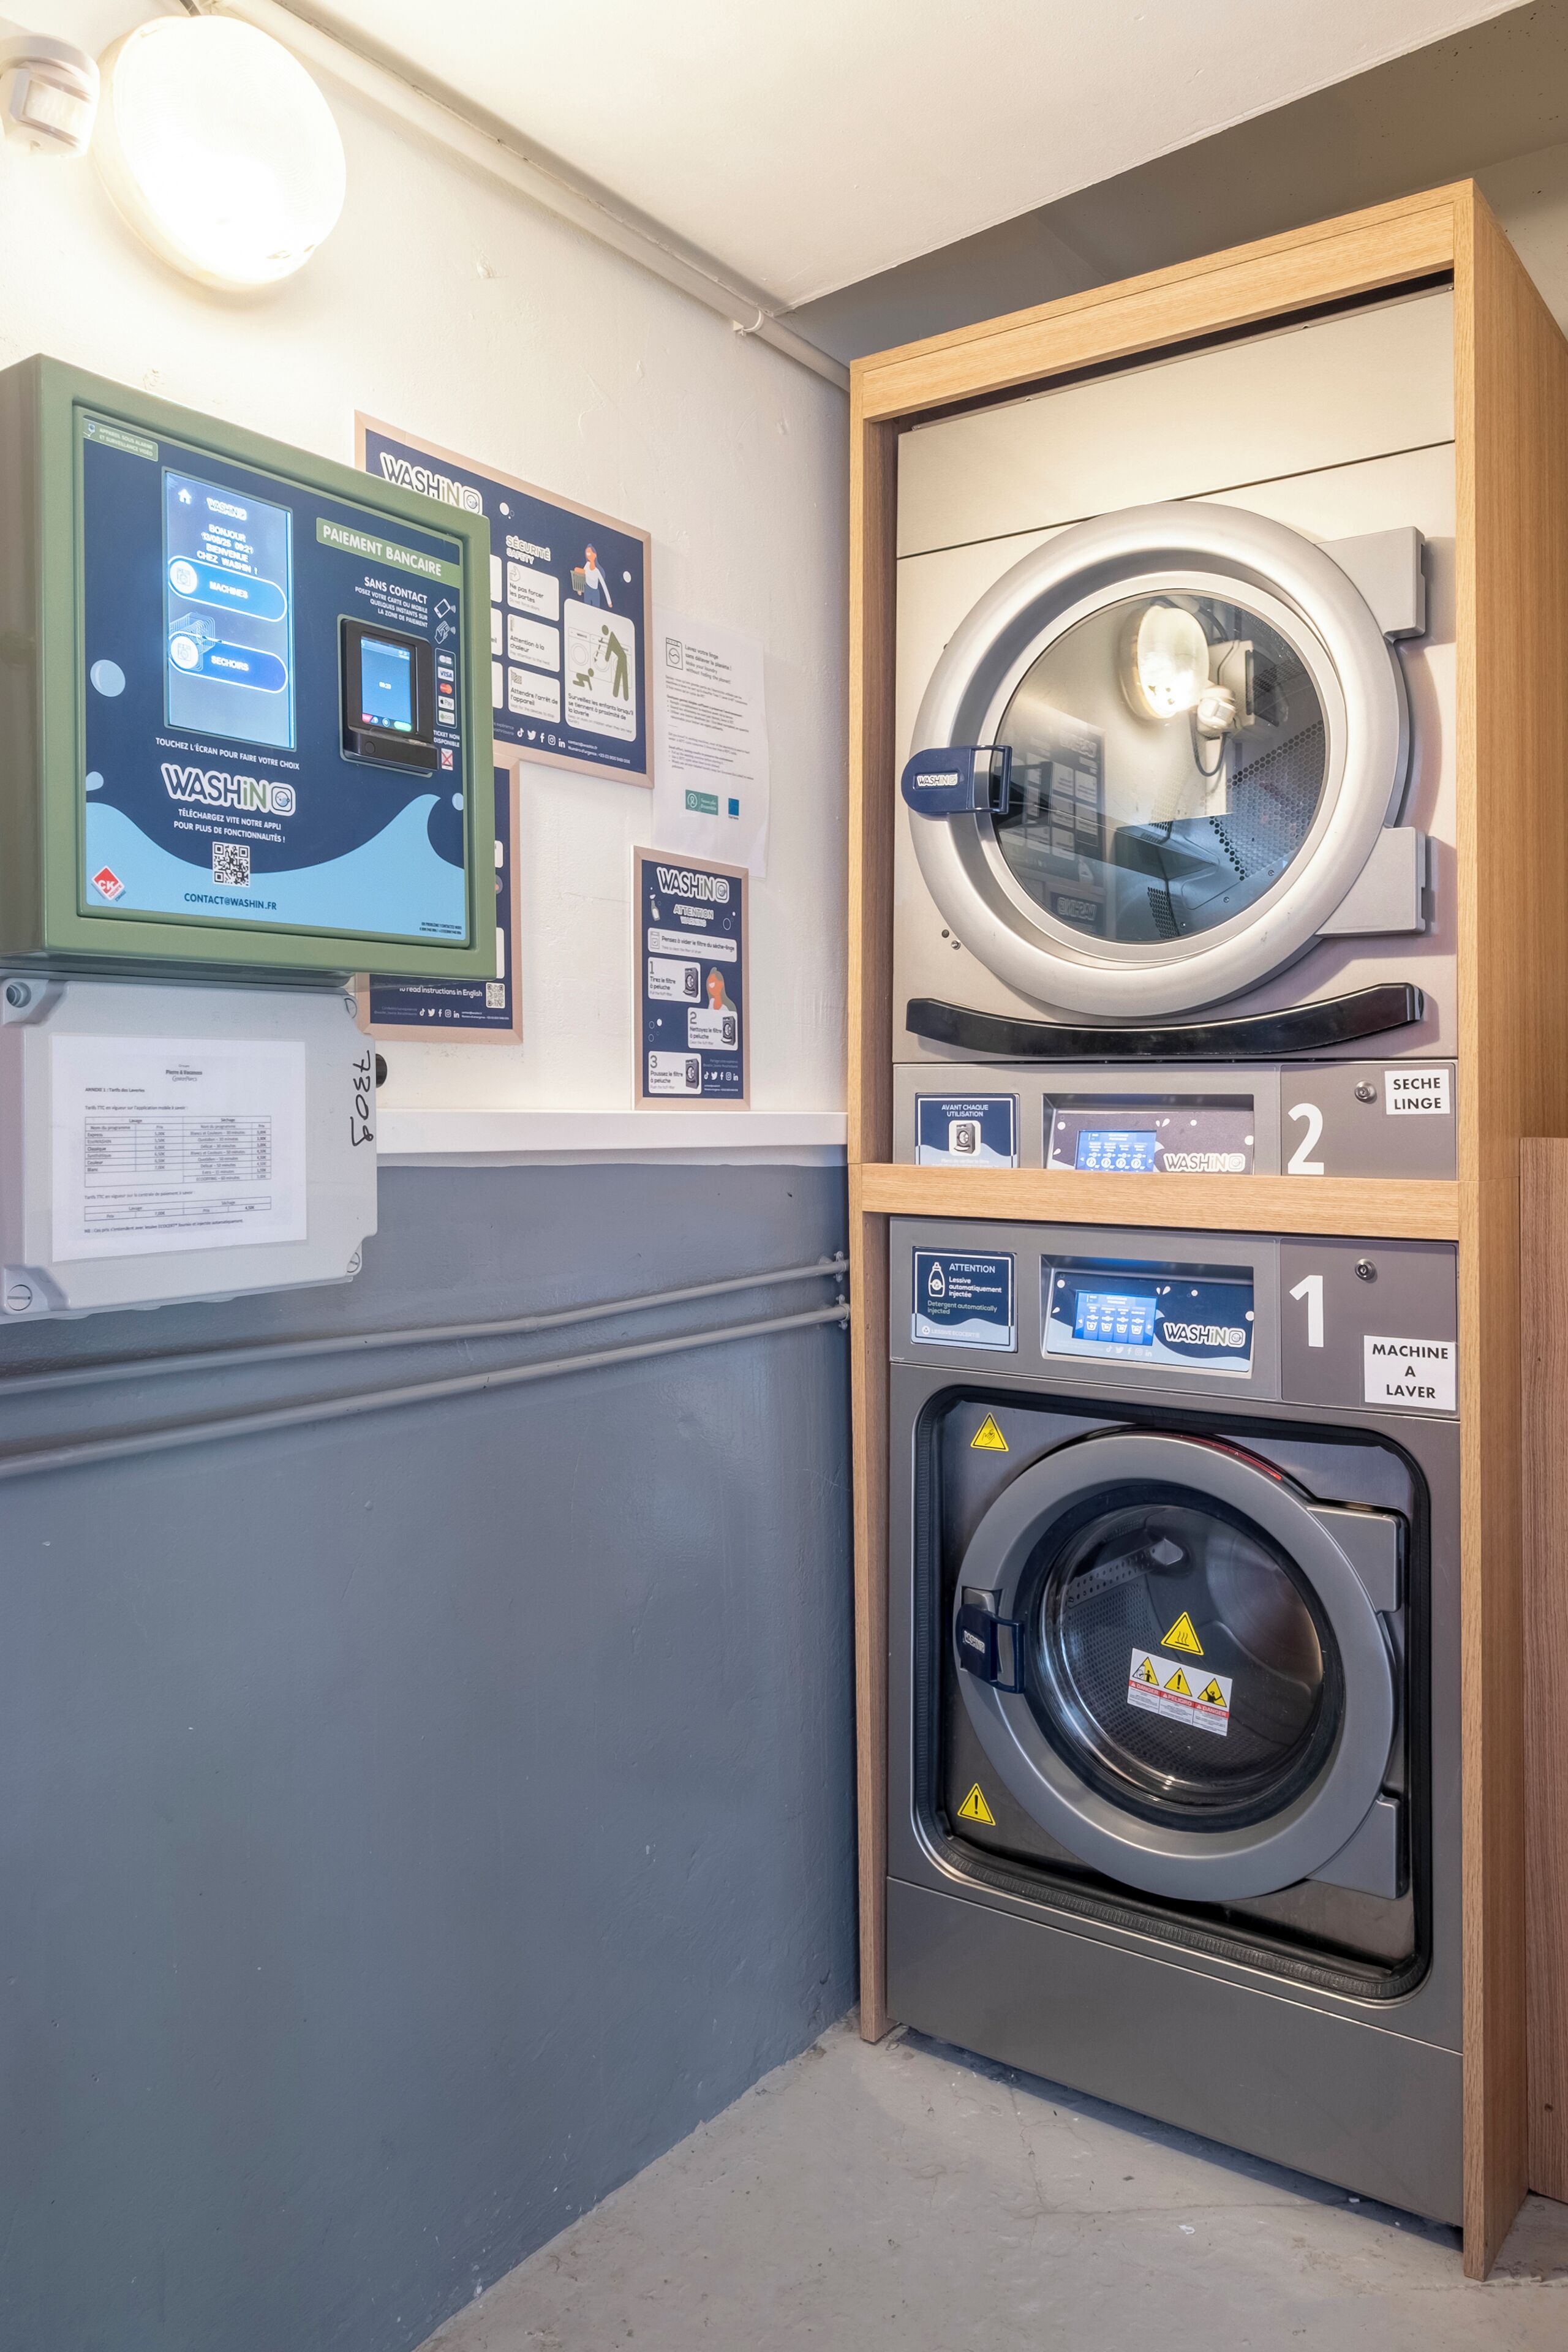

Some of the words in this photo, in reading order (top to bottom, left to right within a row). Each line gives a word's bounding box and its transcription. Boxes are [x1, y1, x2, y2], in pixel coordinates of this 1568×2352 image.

[121, 435, 134, 443] SOUS
[208, 524, 246, 543] BONJOUR
[206, 543, 249, 563] BIENVENUE
[323, 525, 382, 556] PAIEMENT
[386, 546, 442, 576] BANCAIRE
[506, 535, 551, 562] SÉCURITÉ
[197, 550, 219, 564] CHEZ
[221, 557, 252, 573] WASHIN
[506, 547, 535, 565] SAFETY
[209, 581, 248, 599] MACHINES
[364, 576, 387, 592] SANS
[389, 584, 428, 604] CONTACT
[528, 589, 544, 598] forcer
[355, 586, 371, 597] POSEZ
[372, 591, 386, 601] VOTRE
[387, 597, 402, 606] CARTE
[411, 603, 428, 614] MOBILE
[518, 593, 535, 603] portes
[370, 598, 395, 611] QUELQUES
[396, 606, 418, 617] INSTANTS
[385, 610, 398, 619] ZONE
[405, 616, 428, 628] PAIEMENT
[510, 635, 535, 647] Attention
[510, 643, 529, 652] chaleur
[211, 655, 249, 671] SECHOIRS
[511, 687, 534, 698] Attendre
[568, 693, 591, 704] Surveillez
[510, 694, 535, 706] l'appareil
[573, 708, 589, 717] laverie
[575, 702, 594, 712] tiennent
[598, 709, 619, 718] proximité
[433, 729, 448, 739] TICKET
[434, 737, 460, 748] DISPONIBLE
[156, 737, 189, 750] TOUCHEZ
[190, 743, 217, 755] L'ÉCRAN
[219, 750, 238, 760] POUR
[239, 753, 257, 762] FAIRE
[258, 756, 278, 766] VOTRE
[280, 761, 300, 771] CHOIX
[178, 808, 225, 823] TÉLÉCHARGEZ
[226, 816, 240, 824] VITE
[241, 818, 262, 827] NOTRE
[264, 822, 281, 831] APPLI
[174, 821, 193, 831] POUR
[195, 824, 211, 833] PLUS
[224, 827, 282, 842] FONCTIONNALITÉS
[98, 880, 115, 890] CK
[184, 893, 277, 910] CONTACT@WASHIN.FR
[673, 904, 714, 920] ATTENTION
[680, 916, 707, 927] WARNING
[713, 943, 734, 952] sèche-linge
[422, 986, 456, 995] instructions
[462, 990, 483, 998] English
[690, 1012, 697, 1024] 2
[650, 1055, 657, 1068] 3
[1393, 1078, 1441, 1090] SECHE
[1395, 1098, 1441, 1110] LINGE
[1287, 1102, 1324, 1175] 2
[949, 1263, 995, 1273] ATTENTION
[949, 1284, 1002, 1293] automatiquement
[927, 1300, 957, 1310] Detergent
[957, 1303, 997, 1313] automatically
[1289, 1275, 1324, 1348] 1
[1372, 1344, 1449, 1360] MACHINE
[1404, 1366, 1416, 1378] A
[1386, 1384, 1436, 1399] LAVER
[1136, 1684, 1159, 1695] DANGER
[1167, 1694, 1193, 1706] PELIGRO
[1202, 1705, 1226, 1717] DANGER
